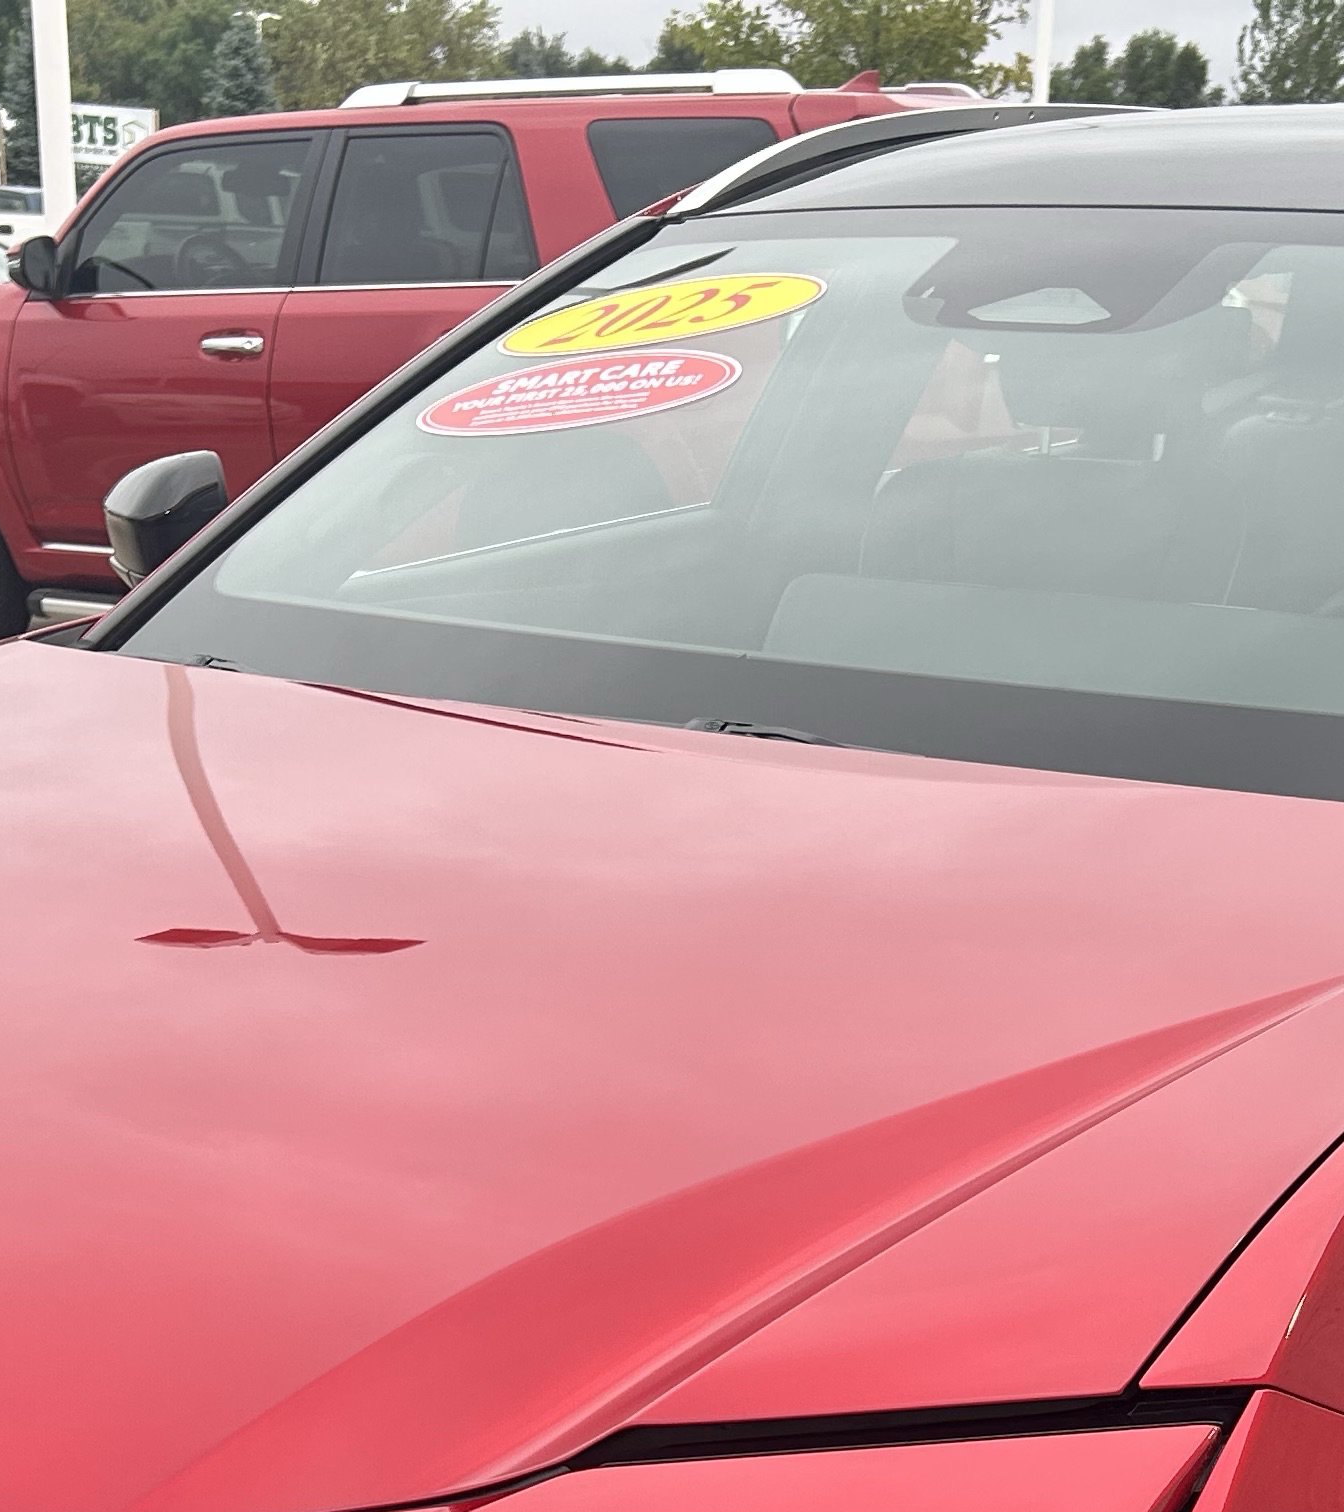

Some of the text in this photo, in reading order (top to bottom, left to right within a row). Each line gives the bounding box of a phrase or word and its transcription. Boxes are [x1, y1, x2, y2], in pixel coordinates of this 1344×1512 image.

[536, 280, 782, 348] 2025
[452, 396, 506, 413] YOUR
[505, 388, 562, 404] FIRST
[629, 377, 665, 390] ON
[665, 374, 704, 387] US!
[492, 360, 685, 395] SMART CARE
